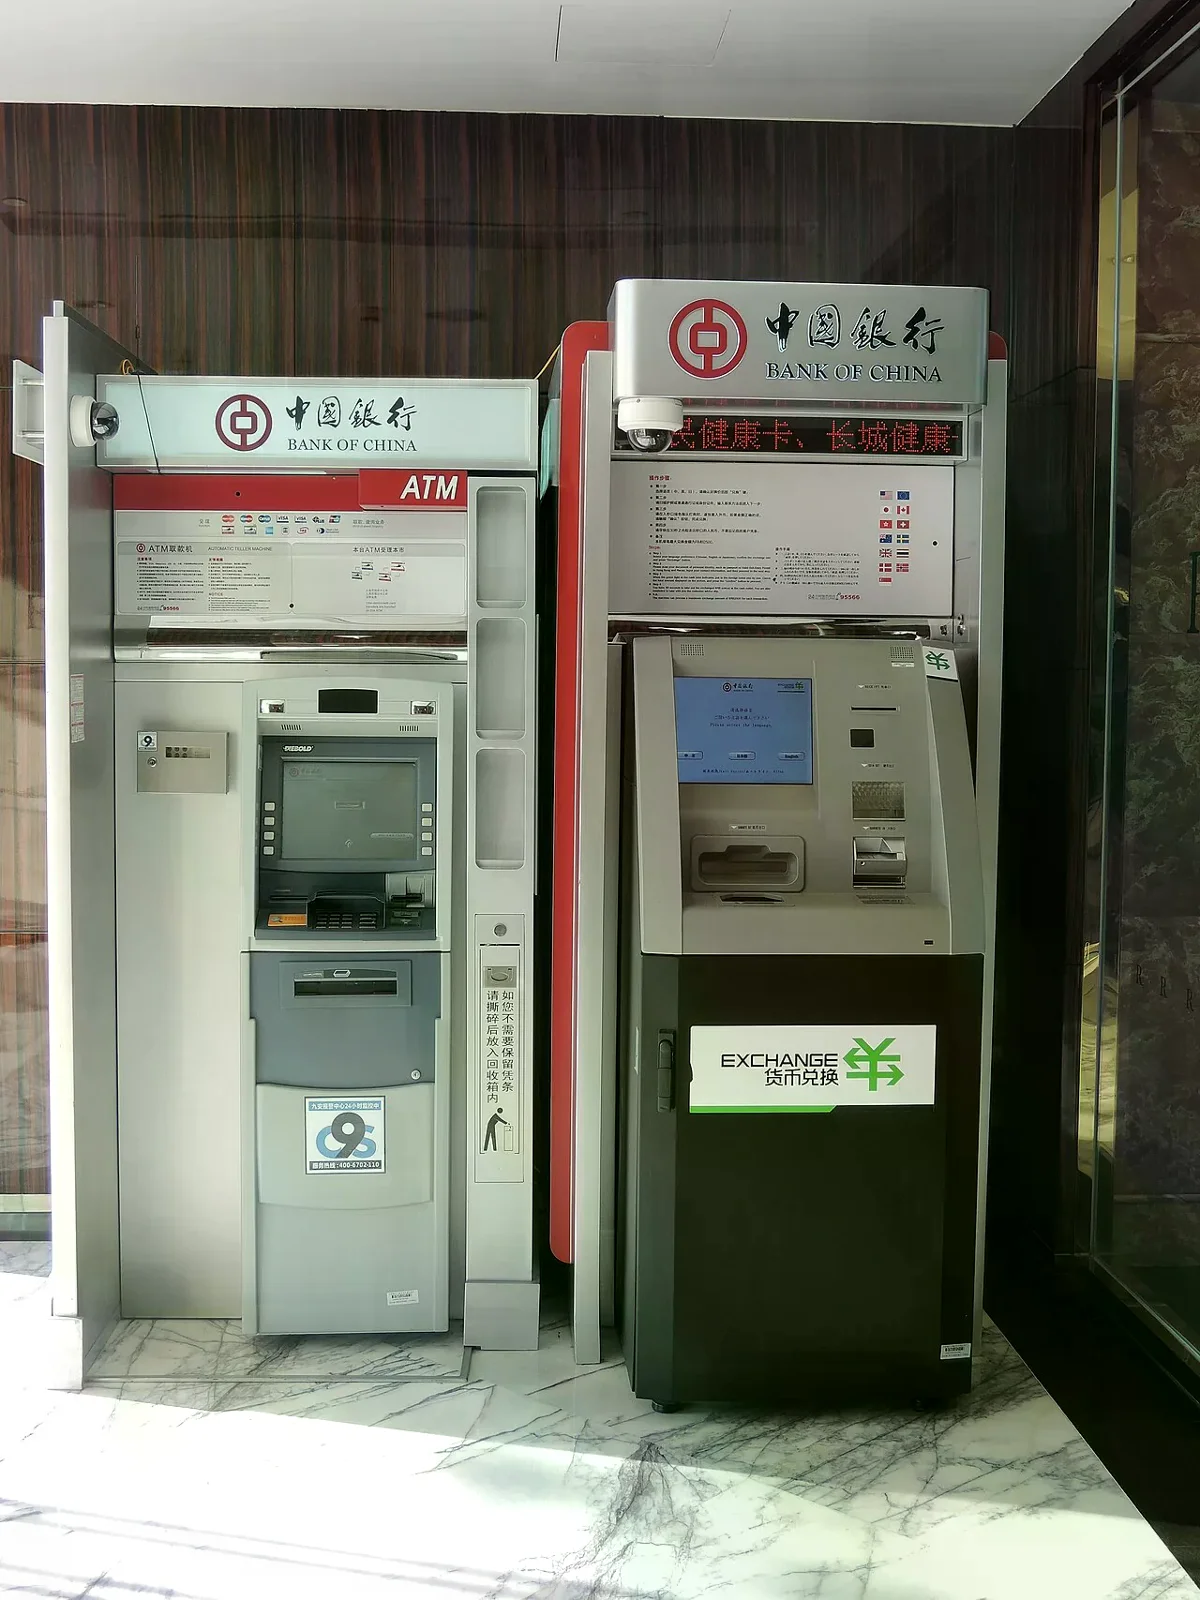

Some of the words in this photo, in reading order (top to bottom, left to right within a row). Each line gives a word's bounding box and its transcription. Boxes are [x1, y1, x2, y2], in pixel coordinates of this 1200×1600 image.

[765, 362, 829, 380] BANK
[834, 364, 864, 382] OF
[869, 364, 943, 383] CHINA
[287, 439, 333, 451] BANK
[337, 439, 358, 451] OF
[363, 439, 418, 452] CHINA
[400, 475, 459, 501] ATM
[486, 990, 499, 1104] 请撕碎后放入回收箱内
[501, 990, 515, 1093] 如您不需要保留凭条
[721, 1053, 839, 1068] EXCHANGE
[764, 1068, 839, 1087] 货币兑换
